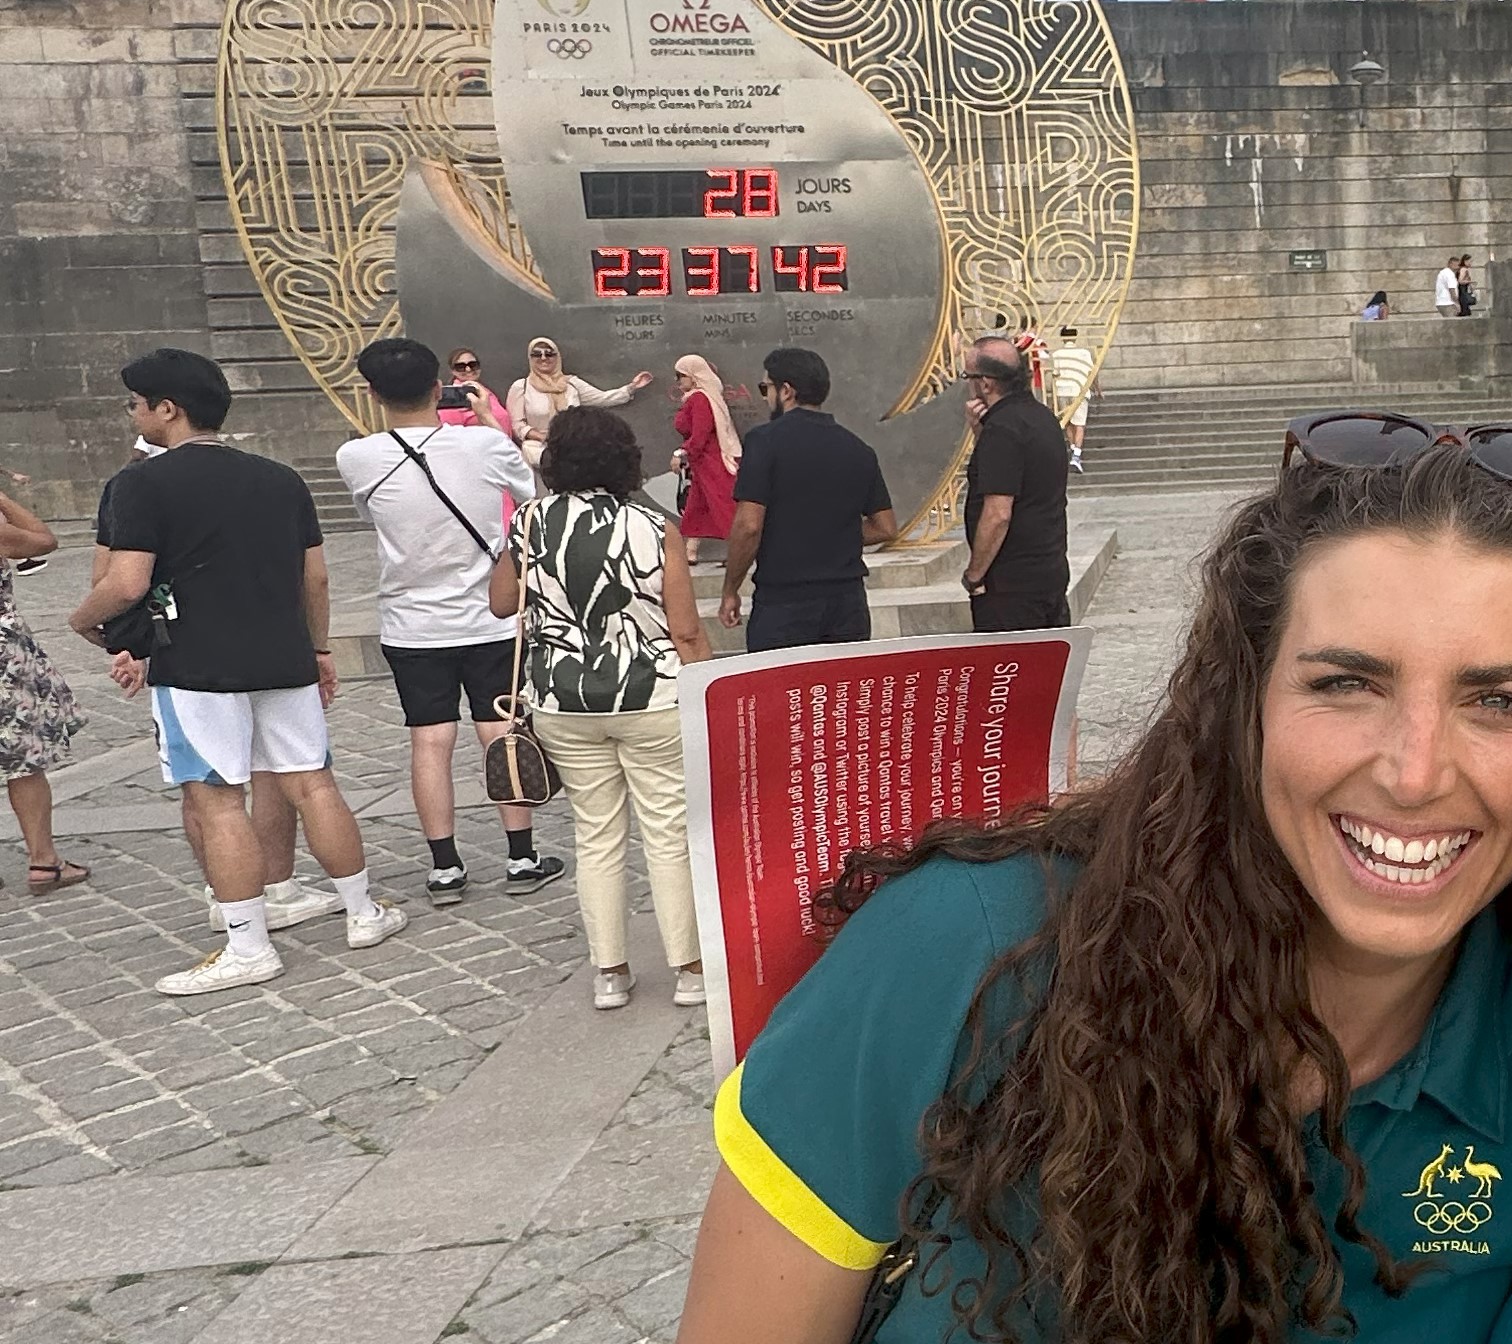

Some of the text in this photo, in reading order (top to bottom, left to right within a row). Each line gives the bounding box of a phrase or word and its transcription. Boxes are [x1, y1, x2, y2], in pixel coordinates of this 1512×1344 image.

[523, 22, 611, 33] PARIS 2024
[650, 13, 751, 34] OMEGA
[650, 47, 756, 57] OFFICIAL TIMEKEEPER
[580, 84, 782, 100] Jeux Olympiques de Paris 2024
[612, 99, 753, 112] Olympic Games Paris 2024
[562, 123, 603, 136] Temps
[606, 124, 644, 135] avant
[647, 122, 660, 134] la
[663, 122, 730, 134] cérémonie
[601, 137, 770, 149] Time until the opening ceremony
[704, 169, 779, 218] 28
[795, 177, 851, 195] JOURS
[797, 200, 832, 213] DAYS
[596, 245, 847, 297] 23 37 42
[614, 309, 854, 328] HEURES MINUTES SECONDES
[904, 671, 920, 684] To
[936, 668, 952, 694] Paris
[786, 688, 804, 721] posts
[855, 678, 876, 715] Simply
[881, 676, 897, 714] chance
[900, 686, 918, 708] help
[952, 666, 975, 745] Congratulations
[810, 684, 828, 737] @Qantas
[832, 681, 852, 738] Instagram
[934, 696, 950, 722] 2024
[790, 722, 805, 742] will
[855, 716, 871, 741] post
[880, 716, 893, 727] to
[836, 740, 847, 751] or
[880, 729, 894, 748] win
[900, 711, 916, 760] celebrate
[977, 662, 1019, 830] Share your journe
[812, 739, 828, 760] and
[857, 743, 869, 751] a
[929, 724, 946, 774] Olympics
[790, 770, 802, 783] so
[836, 752, 850, 791] Twitter
[854, 752, 872, 792] picture
[876, 760, 893, 800] Qantas
[897, 762, 912, 786] your
[949, 760, 964, 793] you're
[788, 786, 805, 803] get
[930, 776, 944, 797] and
[834, 794, 851, 826] using
[858, 794, 872, 806] of
[897, 788, 913, 834] journey,
[952, 796, 962, 810] on
[788, 806, 807, 849] posting
[880, 801, 894, 834] travel
[838, 827, 852, 846] the
[794, 851, 810, 874] and
[793, 876, 812, 906] good
[1412, 1240, 1490, 1255] AUSTRALIA
